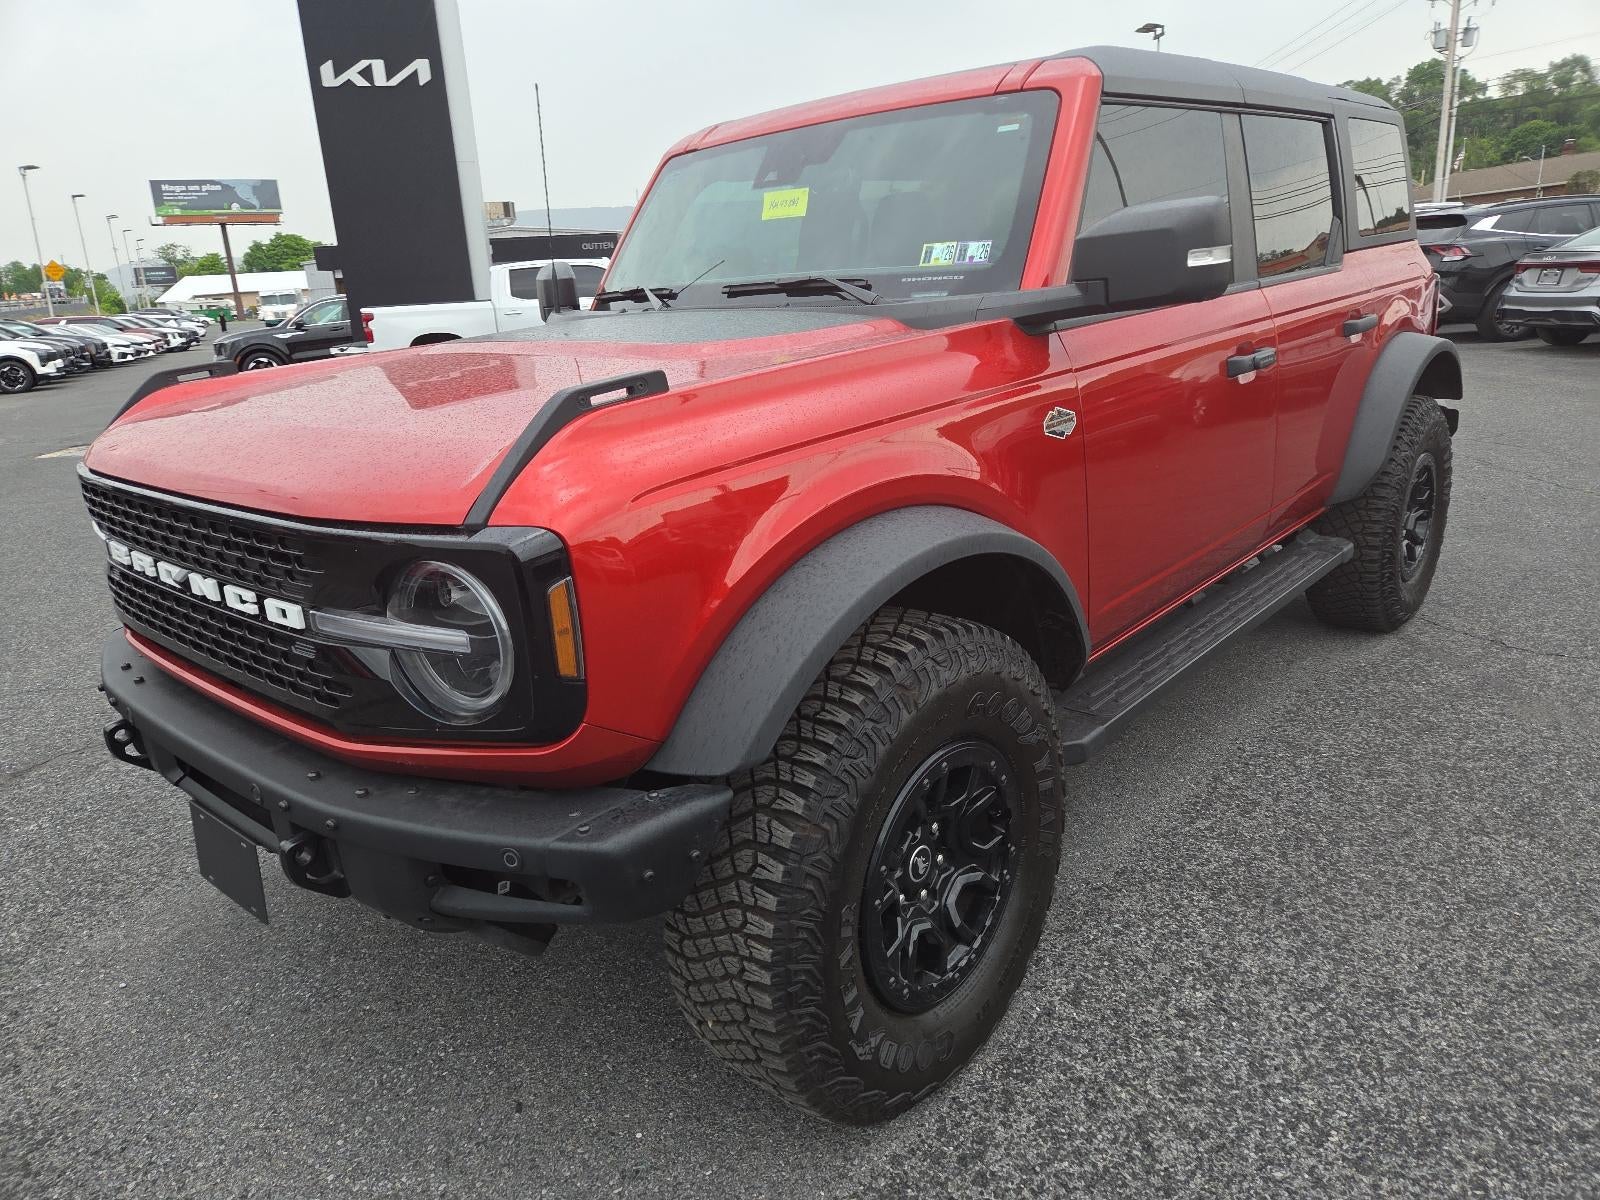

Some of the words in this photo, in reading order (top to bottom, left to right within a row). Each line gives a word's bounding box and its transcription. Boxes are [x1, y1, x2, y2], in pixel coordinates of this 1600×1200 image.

[319, 58, 431, 87] KIA
[160, 184, 187, 192] Haga
[581, 241, 614, 250] OUTTEN
